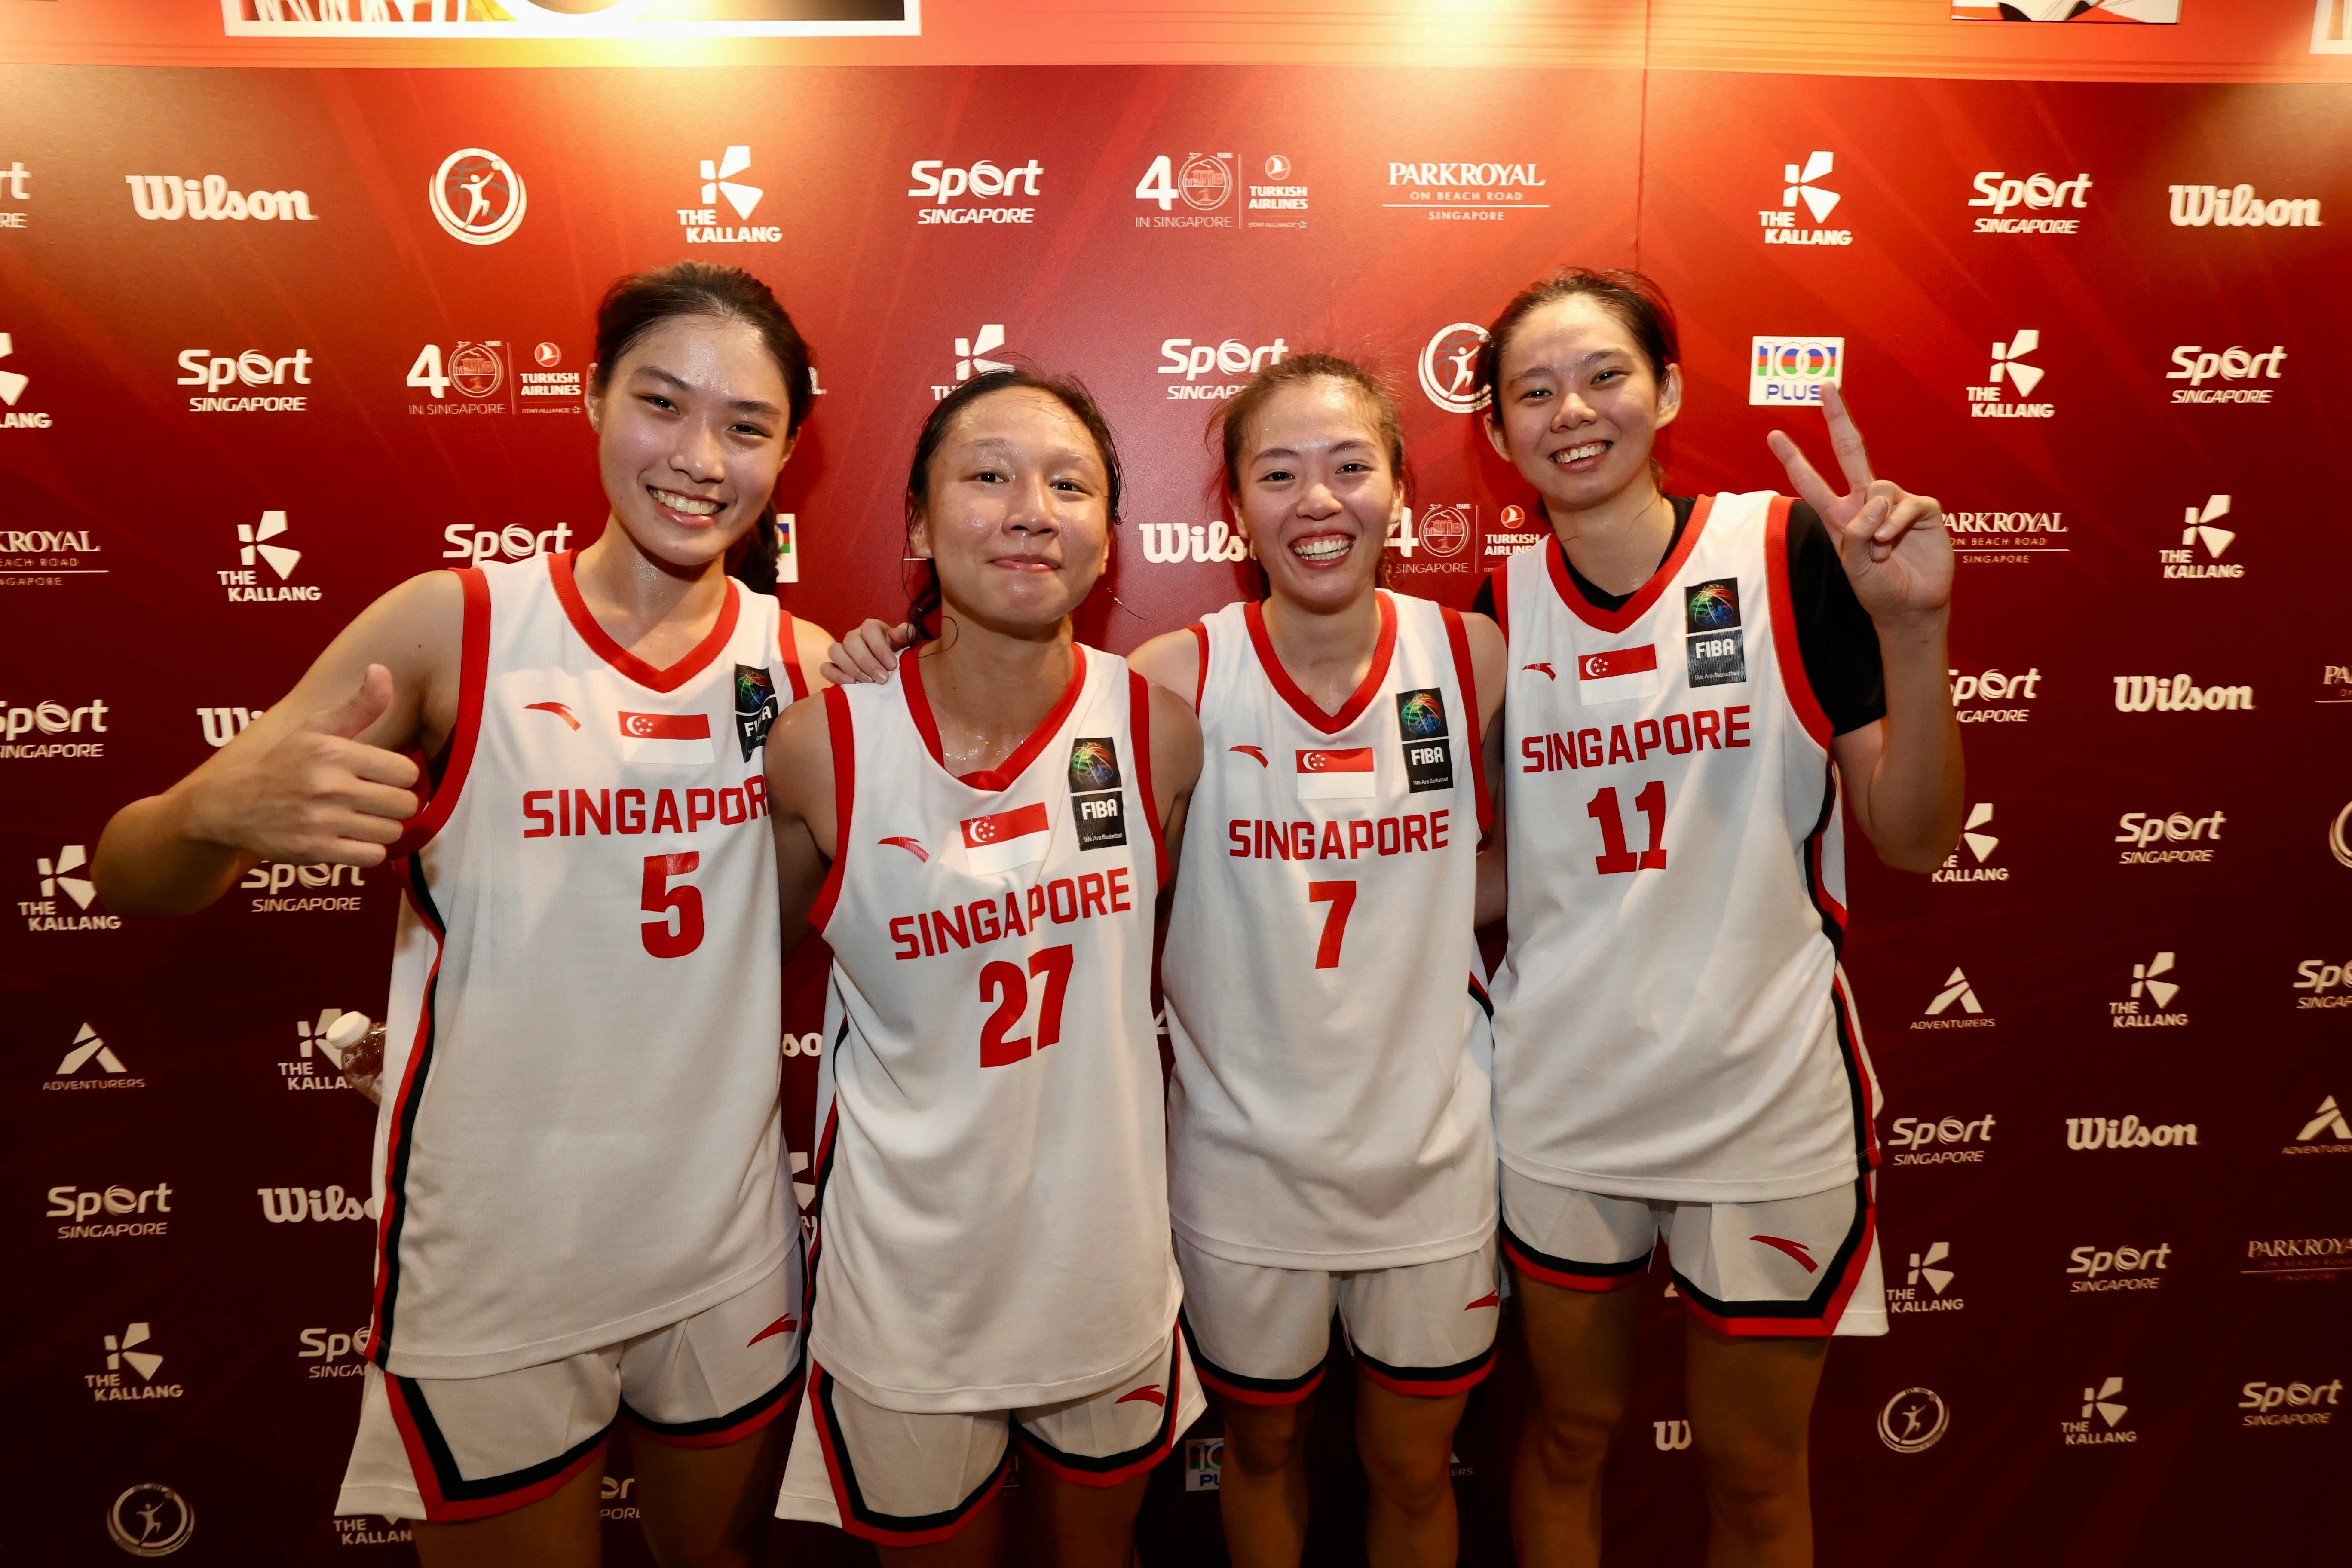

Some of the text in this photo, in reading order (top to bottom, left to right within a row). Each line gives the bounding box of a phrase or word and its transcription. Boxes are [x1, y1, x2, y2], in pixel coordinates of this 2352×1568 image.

[1388, 162, 1545, 186] PARKROYAL
[908, 160, 1044, 204] Sport
[125, 175, 317, 220] Wilson
[1249, 186, 1308, 196] TURKISH
[1410, 191, 1523, 200] ON BEACH ROAD
[1968, 172, 2092, 214] Sport
[1248, 199, 1308, 209] AIRLINES
[2169, 184, 2321, 226] Wilson
[677, 209, 716, 225] THE
[918, 208, 1035, 224] SINGAPORE
[1135, 216, 1234, 228] IN SINGAPORE
[1428, 211, 1504, 220] SINGAPORE
[1759, 211, 1795, 227] THE
[1973, 218, 2080, 233] SINGAPORE
[686, 227, 782, 243] KALLANG
[1765, 229, 1853, 245] KALLANG
[1756, 342, 1832, 381] 100
[2166, 346, 2287, 386] Sport
[177, 349, 312, 392] Sport
[520, 373, 579, 383] TURKISH
[521, 385, 581, 395] AIRLINES
[1166, 384, 1240, 401] SINGAP
[1765, 384, 1822, 401] PLUS
[1966, 387, 2000, 401] THE
[2170, 390, 2274, 403] SINGAPORE
[189, 397, 307, 411] SINGAPORE
[409, 403, 507, 415] IN SINGAPORE
[1971, 403, 2055, 417] KALLANG
[1942, 512, 2070, 533] ARKROYAL
[1485, 534, 1540, 544] TURKISH
[1484, 545, 1533, 556] AIRLINE
[2159, 550, 2193, 563] THE
[1962, 555, 2031, 564] SINGAPORE
[217, 571, 257, 585] THE
[2164, 564, 2244, 578] KALLANG
[228, 586, 322, 601] KALLANG
[1695, 638, 1735, 659] FIBA
[2114, 674, 2254, 712] Wilson
[1522, 705, 1751, 773] SINGAPORE
[1411, 746, 1444, 766] FIBA
[522, 775, 771, 839] SINGAPOR
[1081, 799, 1118, 820] FIBA
[1229, 809, 1449, 860] SINGAPORE
[1586, 781, 1667, 875] 11
[2115, 811, 2226, 848] Sport
[1102, 832, 1123, 840] Basketball
[2119, 850, 2214, 864] SINGAPORE
[1931, 868, 2010, 882] KALLANG
[18, 901, 56, 915] THE
[251, 897, 361, 912] SINGAPORE
[640, 851, 705, 959] 5
[889, 867, 1131, 960] SINGAPORE
[28, 916, 121, 931] KALLANG
[1308, 880, 1357, 970] 7
[979, 944, 1074, 1068] 27
[2109, 1002, 2139, 1014] THE
[1910, 1019, 1995, 1029] ADVENTURERS
[2113, 1014, 2187, 1027] KALLANG
[278, 1062, 313, 1075] THE
[43, 1079, 145, 1090] ADVENTURERS
[287, 1076, 353, 1090] KALLA
[1888, 1114, 1995, 1150] Sport
[2066, 1115, 2197, 1150] Wilson
[1893, 1151, 1985, 1165] SINGAPORE
[47, 1183, 172, 1222] Sport
[257, 1185, 378, 1223] Wils
[58, 1222, 167, 1239] SINGAPORE
[2066, 1243, 2171, 1277] Sport
[2070, 1278, 2160, 1292] SINGAPORE
[1886, 1289, 1915, 1300] THE
[1891, 1298, 1963, 1313] KALLANG
[308, 1364, 367, 1378] SINGA
[84, 1374, 120, 1387] THE
[95, 1385, 183, 1401] KALLANG
[2239, 1380, 2342, 1412] Sport
[2061, 1421, 2089, 1433] THE
[2242, 1413, 2331, 1426] SINGAPORE
[2066, 1431, 2137, 1444] KALLANG
[333, 1519, 366, 1531] THE
[341, 1529, 413, 1545] KALLAN
